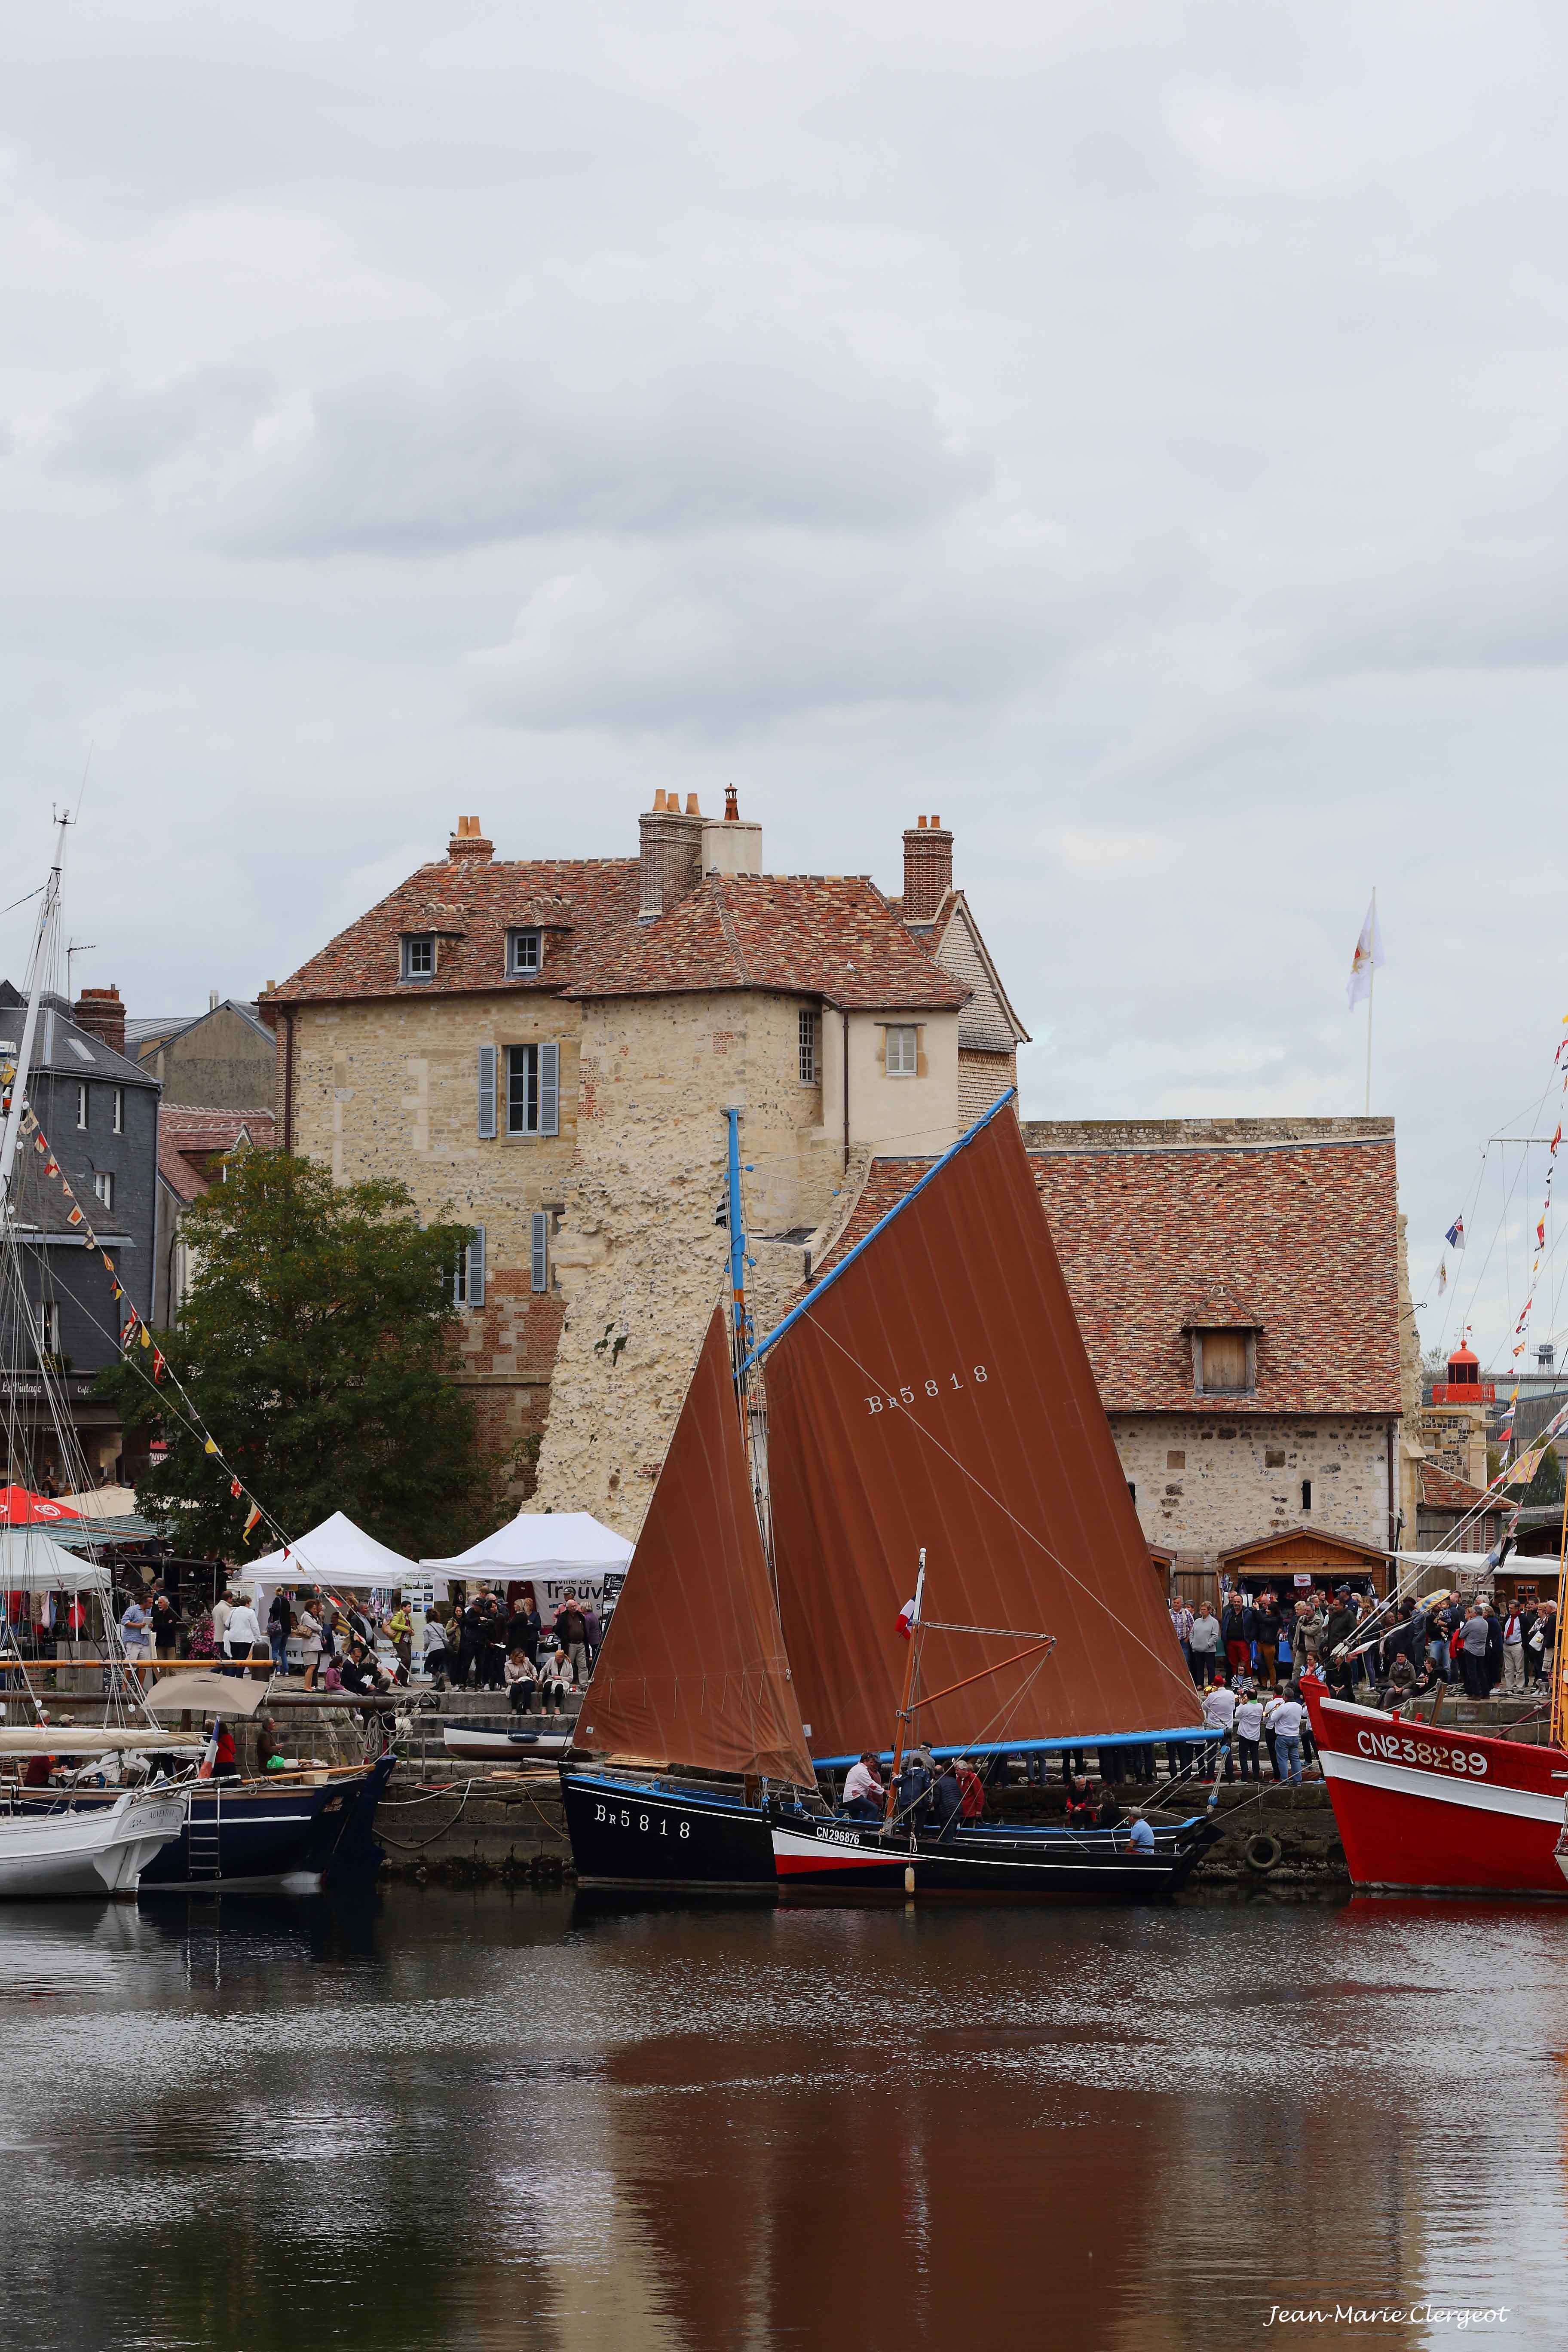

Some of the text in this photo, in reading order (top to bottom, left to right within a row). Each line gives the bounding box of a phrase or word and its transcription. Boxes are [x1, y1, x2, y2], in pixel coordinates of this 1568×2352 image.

[2, 1382, 12, 1393] Le
[13, 1382, 42, 1396] Vintage
[1357, 1731, 1487, 1775] CN238289
